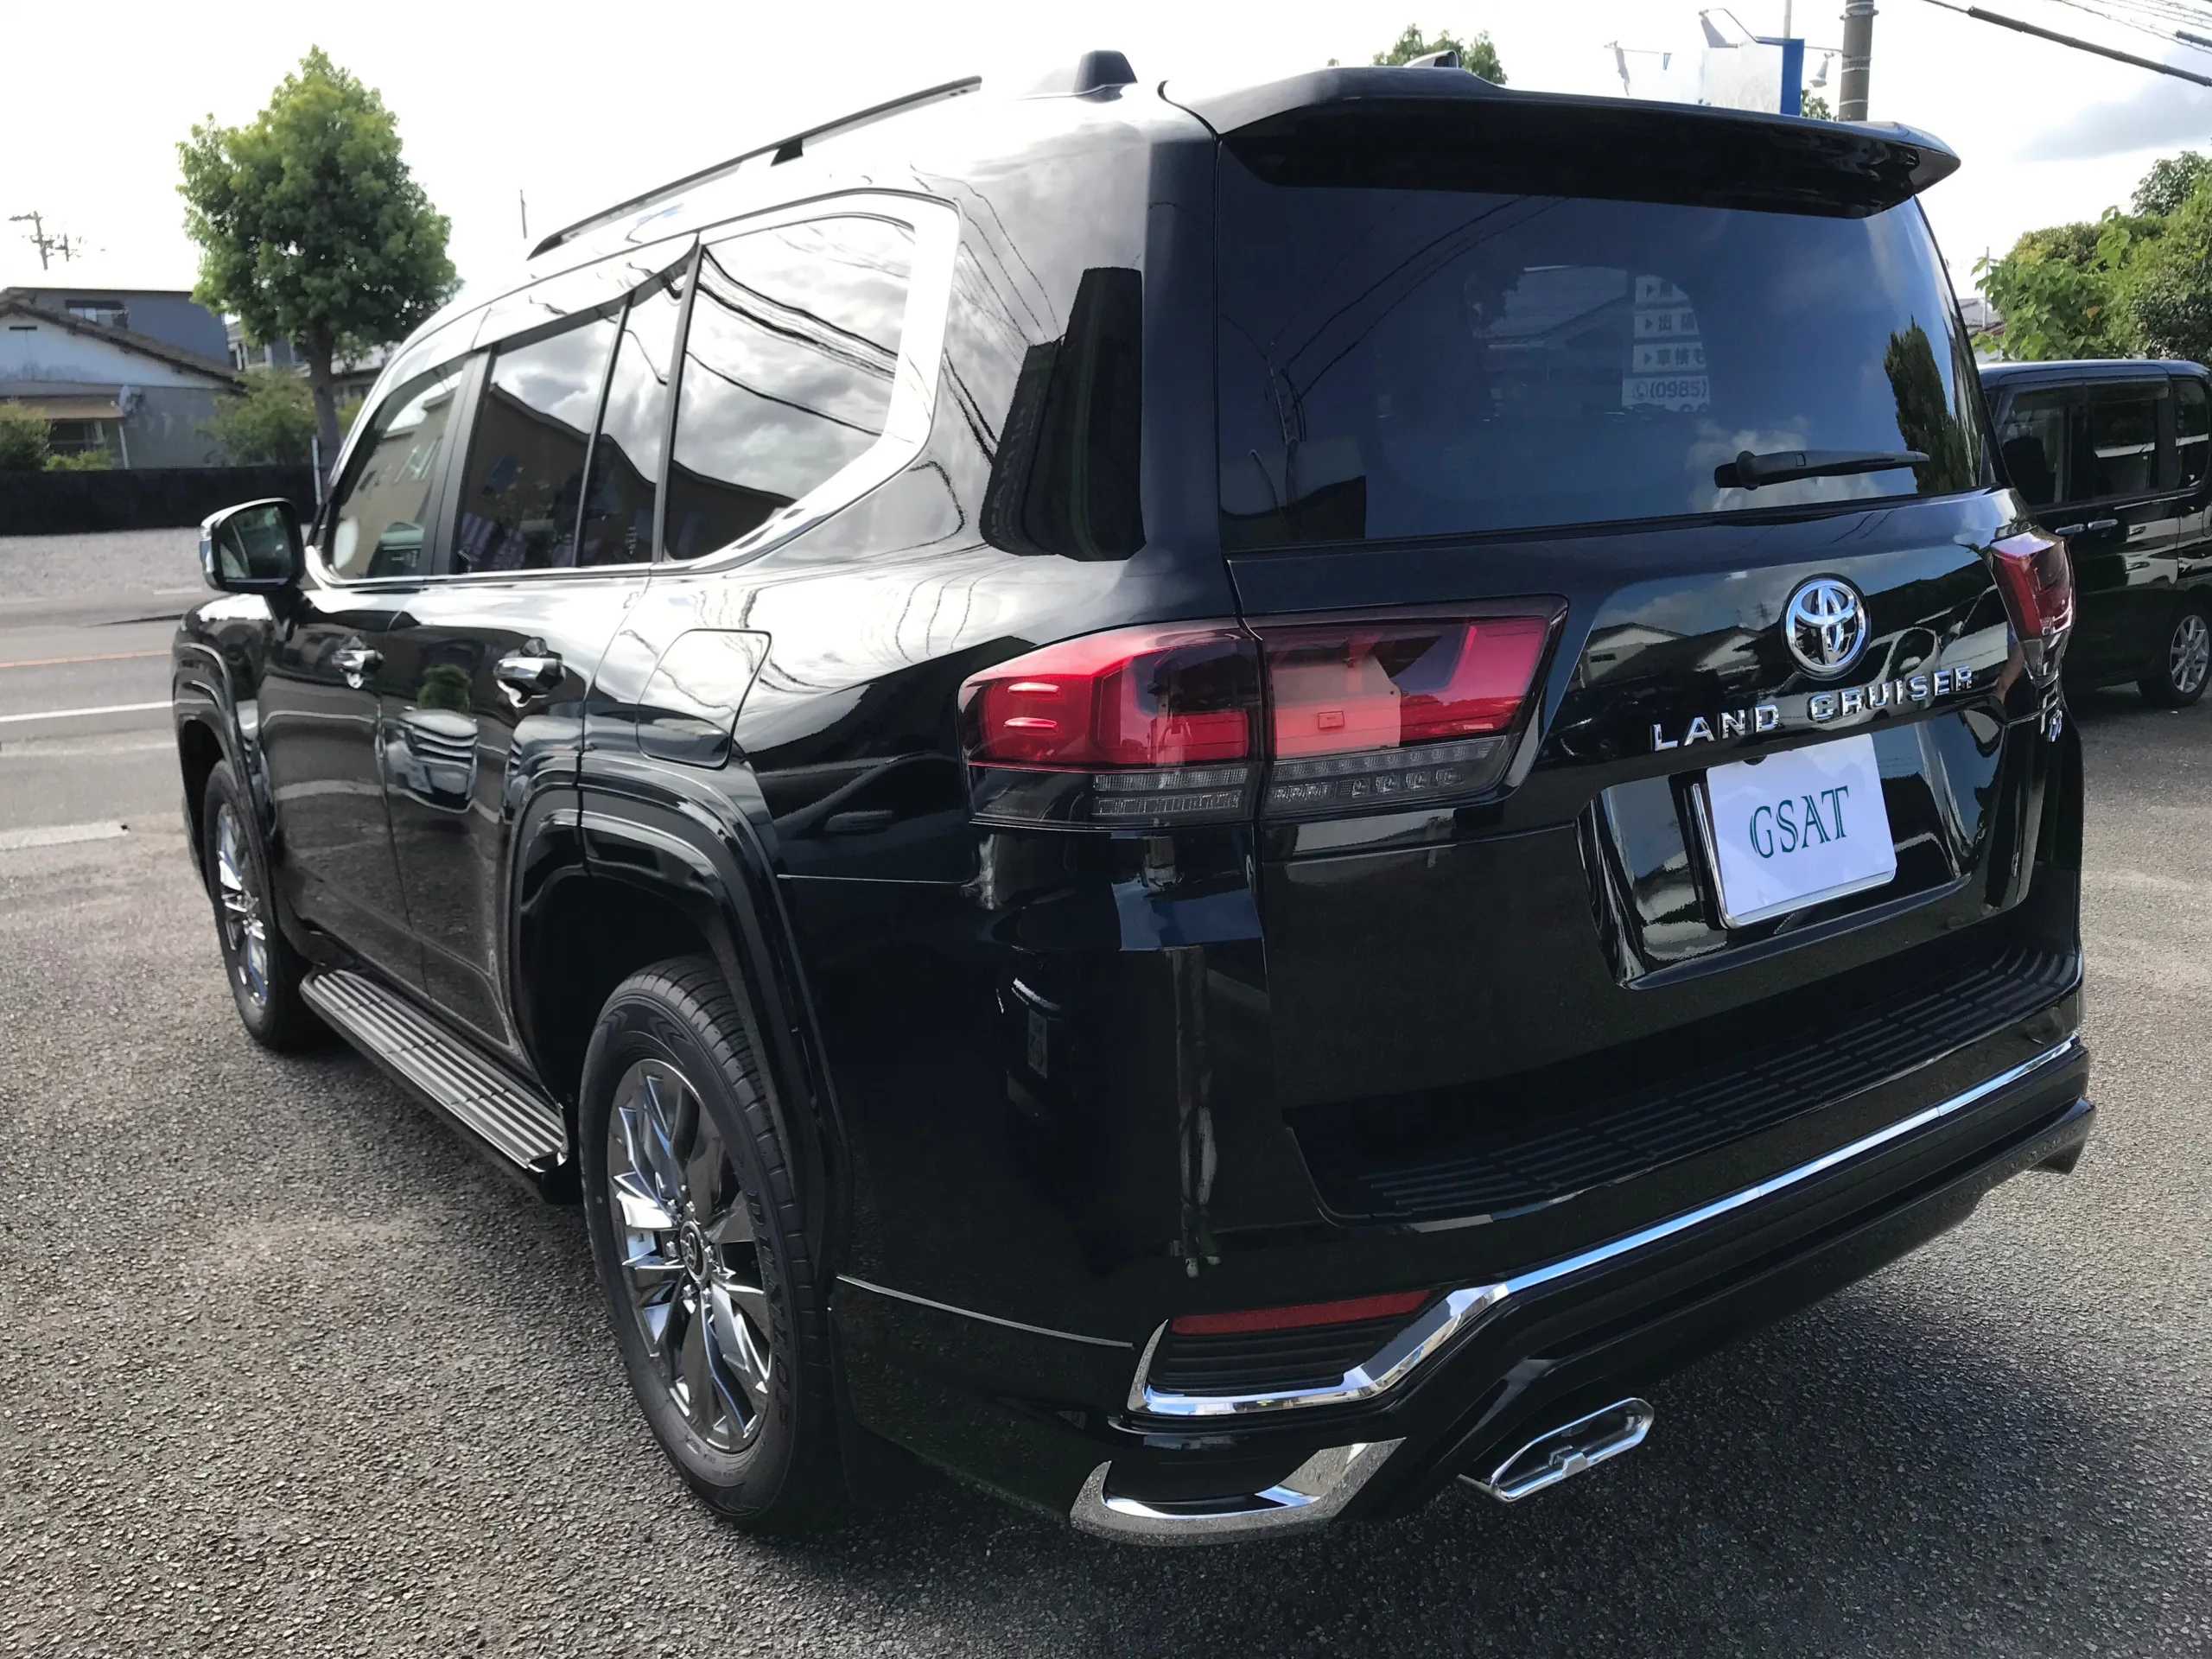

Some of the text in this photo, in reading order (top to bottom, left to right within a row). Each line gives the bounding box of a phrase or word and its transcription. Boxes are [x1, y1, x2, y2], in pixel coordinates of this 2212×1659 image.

[1650, 379, 1707, 400] (0985)
[1651, 665, 1974, 752] LAND CRUISER
[1749, 785, 1850, 859] GSAT
